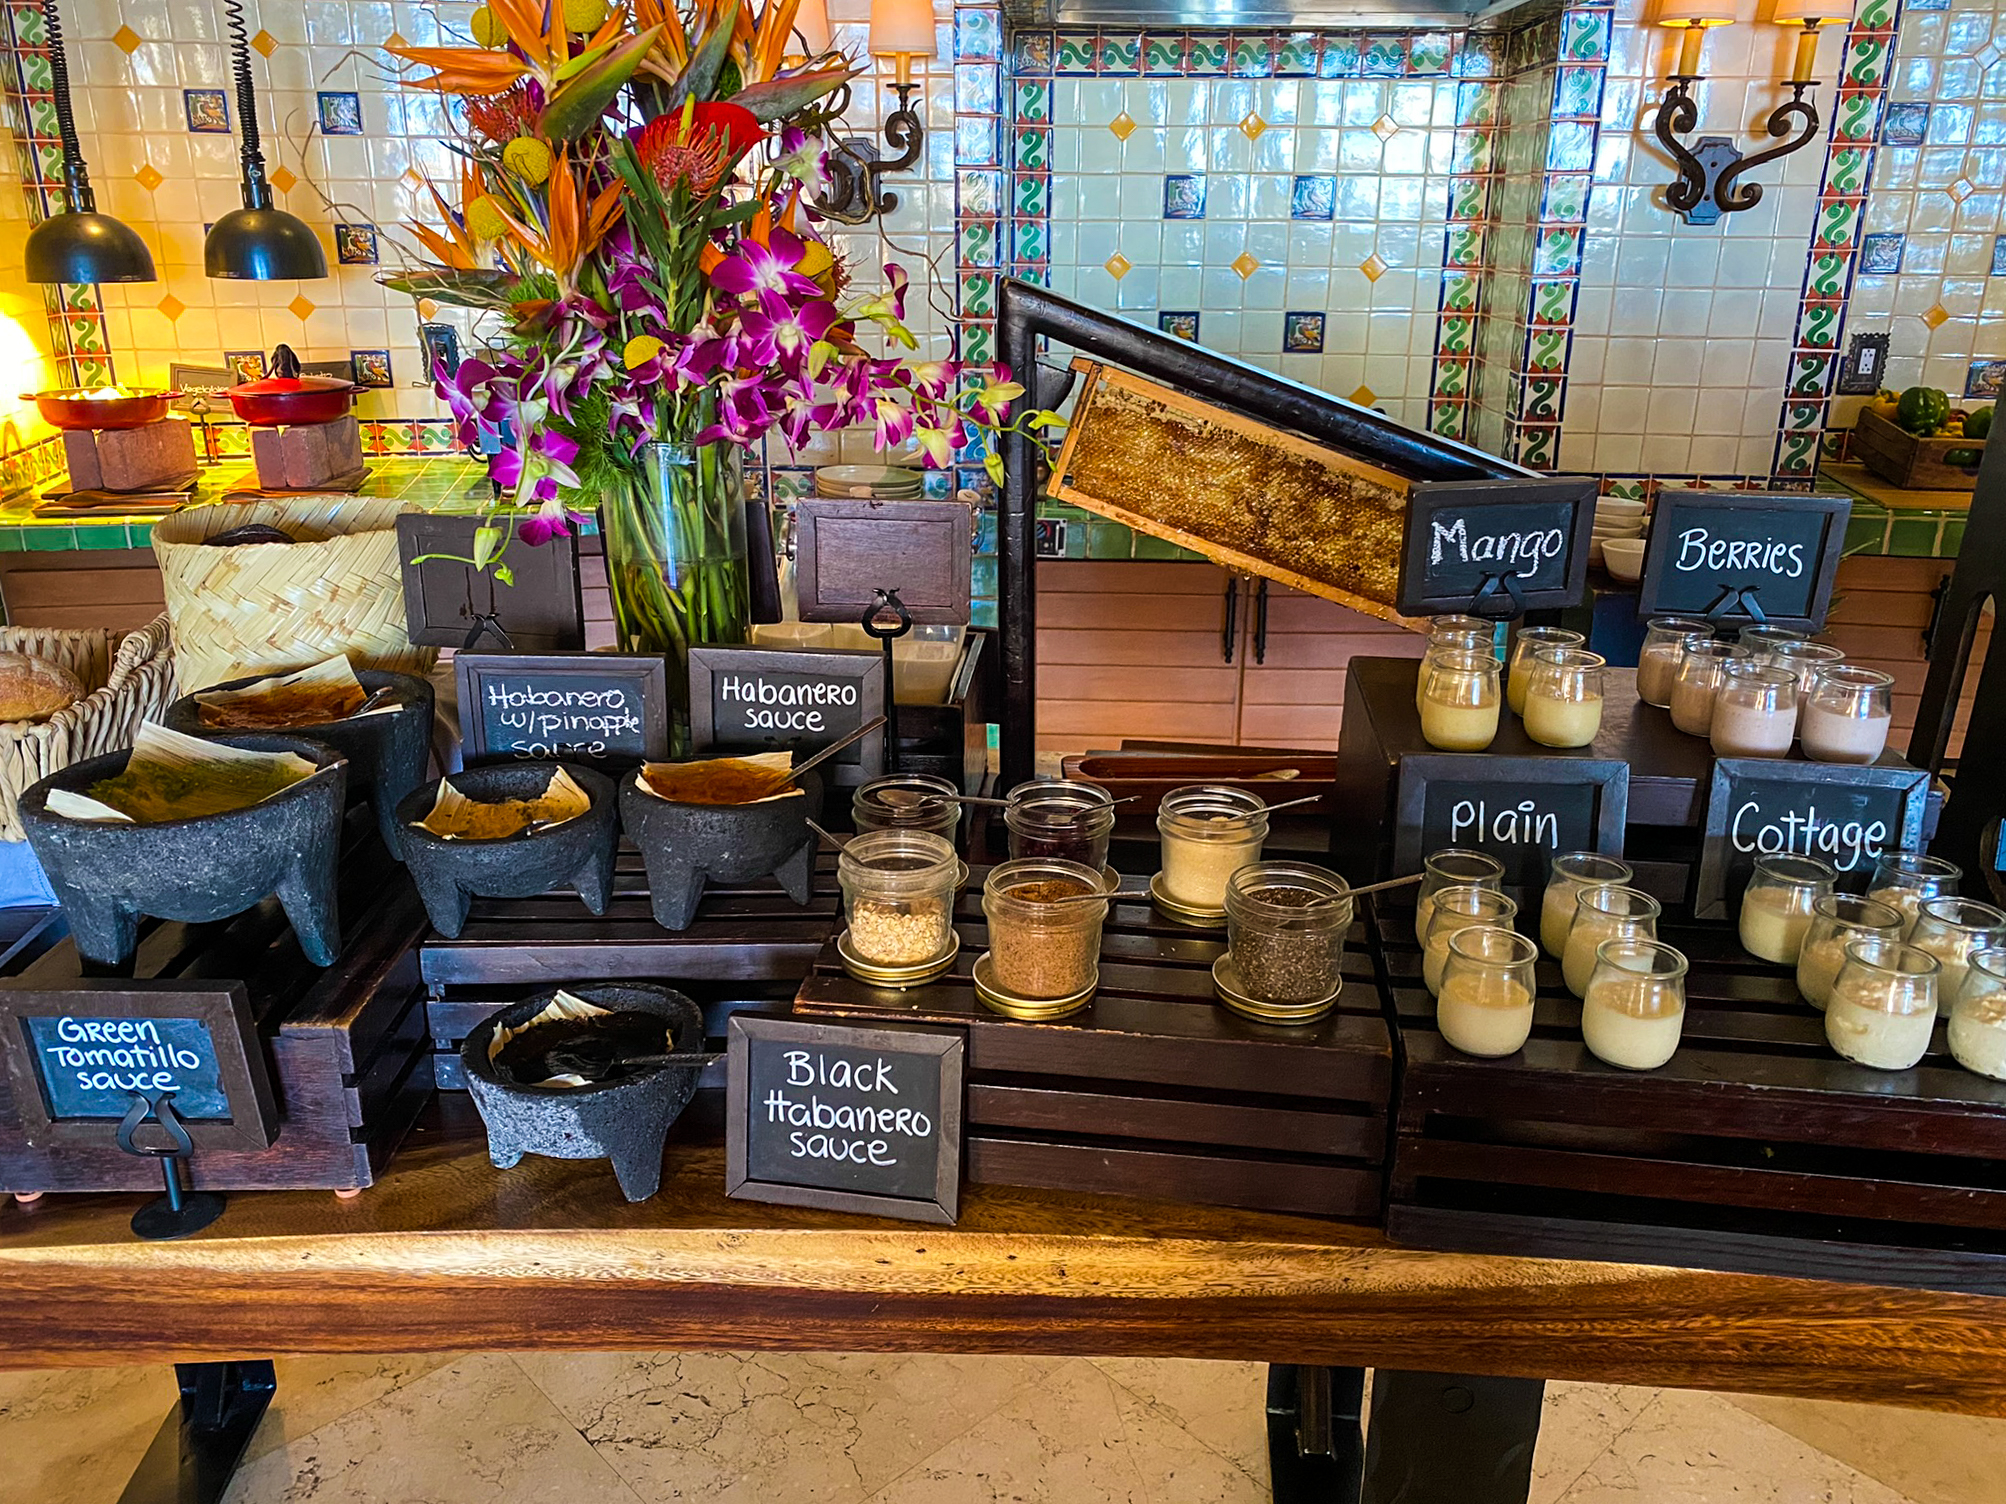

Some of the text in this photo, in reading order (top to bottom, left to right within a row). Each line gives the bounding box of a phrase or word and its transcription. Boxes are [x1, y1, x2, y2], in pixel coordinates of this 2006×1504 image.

[1430, 518, 1563, 578] Mango
[1675, 528, 1804, 578] Berries
[488, 683, 625, 709] Habanero
[722, 676, 857, 706] Habanero
[744, 708, 825, 732] sauce
[1451, 800, 1559, 849] Plain
[1732, 802, 1887, 872] Cottage
[57, 1016, 161, 1045] Green
[47, 1043, 200, 1069] Tomatillo
[783, 1051, 899, 1094] Black
[77, 1071, 181, 1091] sauce
[763, 1089, 931, 1137] Habanero
[790, 1131, 897, 1167] sauce
